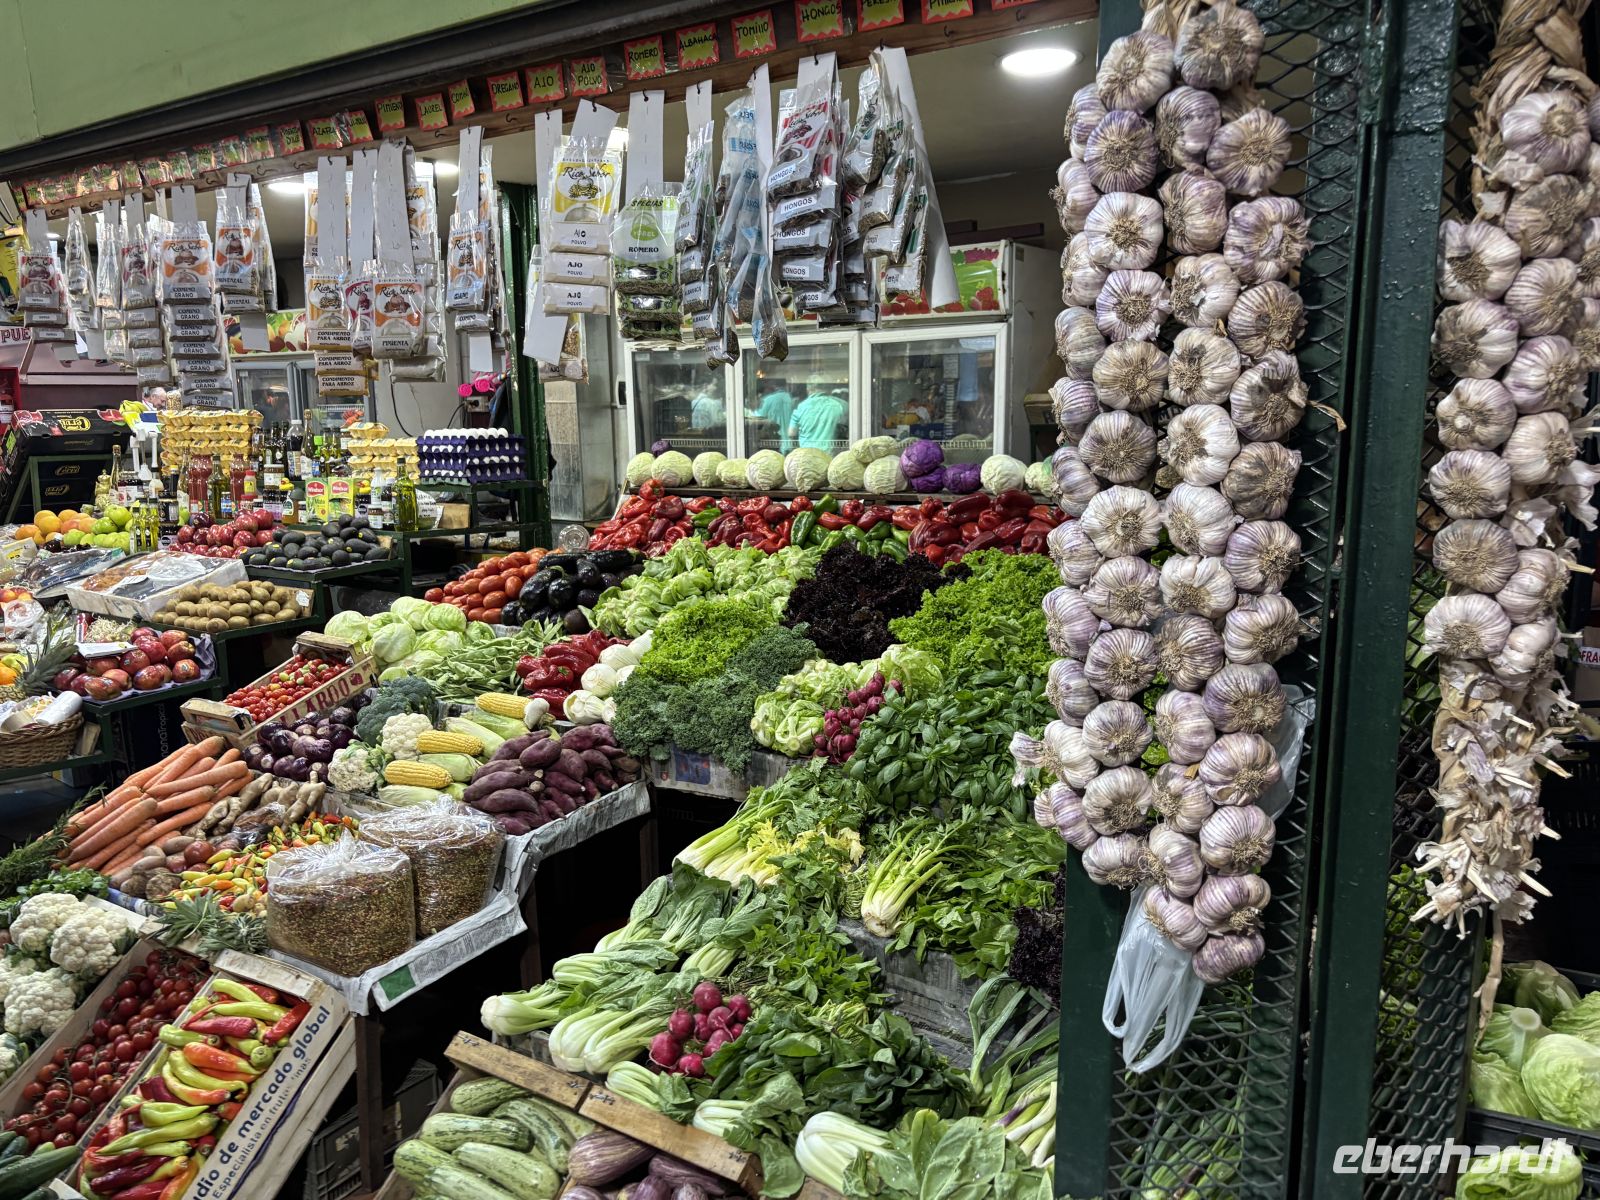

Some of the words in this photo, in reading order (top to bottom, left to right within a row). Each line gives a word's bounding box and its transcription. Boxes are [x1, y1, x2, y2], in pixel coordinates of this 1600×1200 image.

[802, 4, 841, 22] HONGOS
[628, 47, 659, 63] ROMERO
[581, 64, 595, 74] AJO
[534, 76, 555, 89] AJO
[578, 75, 602, 87] POLVO
[492, 82, 519, 95] OREGANO
[770, 167, 793, 183] HONGOS
[784, 197, 813, 211] HONGOS
[777, 229, 806, 238] HONGOS
[567, 262, 583, 270] AJO
[567, 291, 582, 299] AJO
[219, 1142, 239, 1165] de
[238, 1062, 293, 1139] mercado
[293, 1006, 330, 1060] global
[212, 1130, 262, 1199] Especialista
[261, 1116, 272, 1131] en
